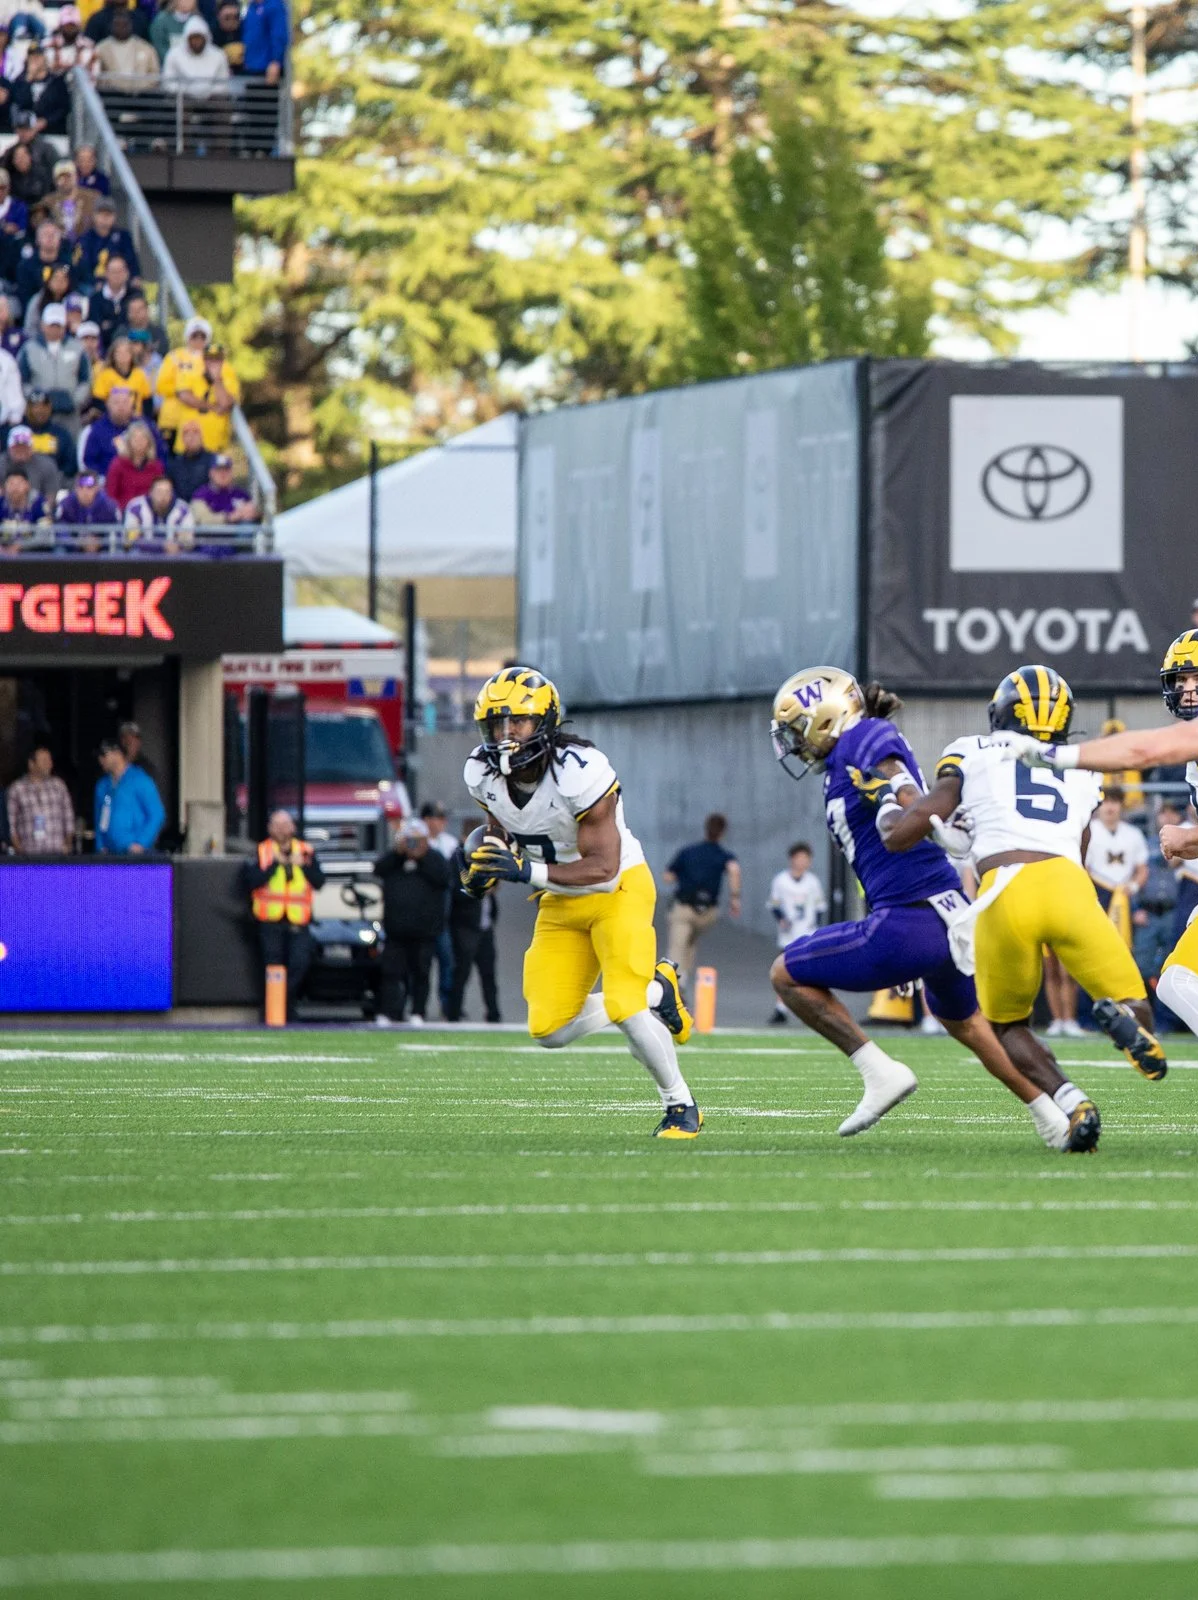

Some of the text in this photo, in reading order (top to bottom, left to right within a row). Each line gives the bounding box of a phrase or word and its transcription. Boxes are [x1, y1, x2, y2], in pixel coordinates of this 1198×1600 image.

[922, 607, 1150, 654] TOYOTA
[793, 680, 823, 709] W
[937, 893, 957, 912] W
